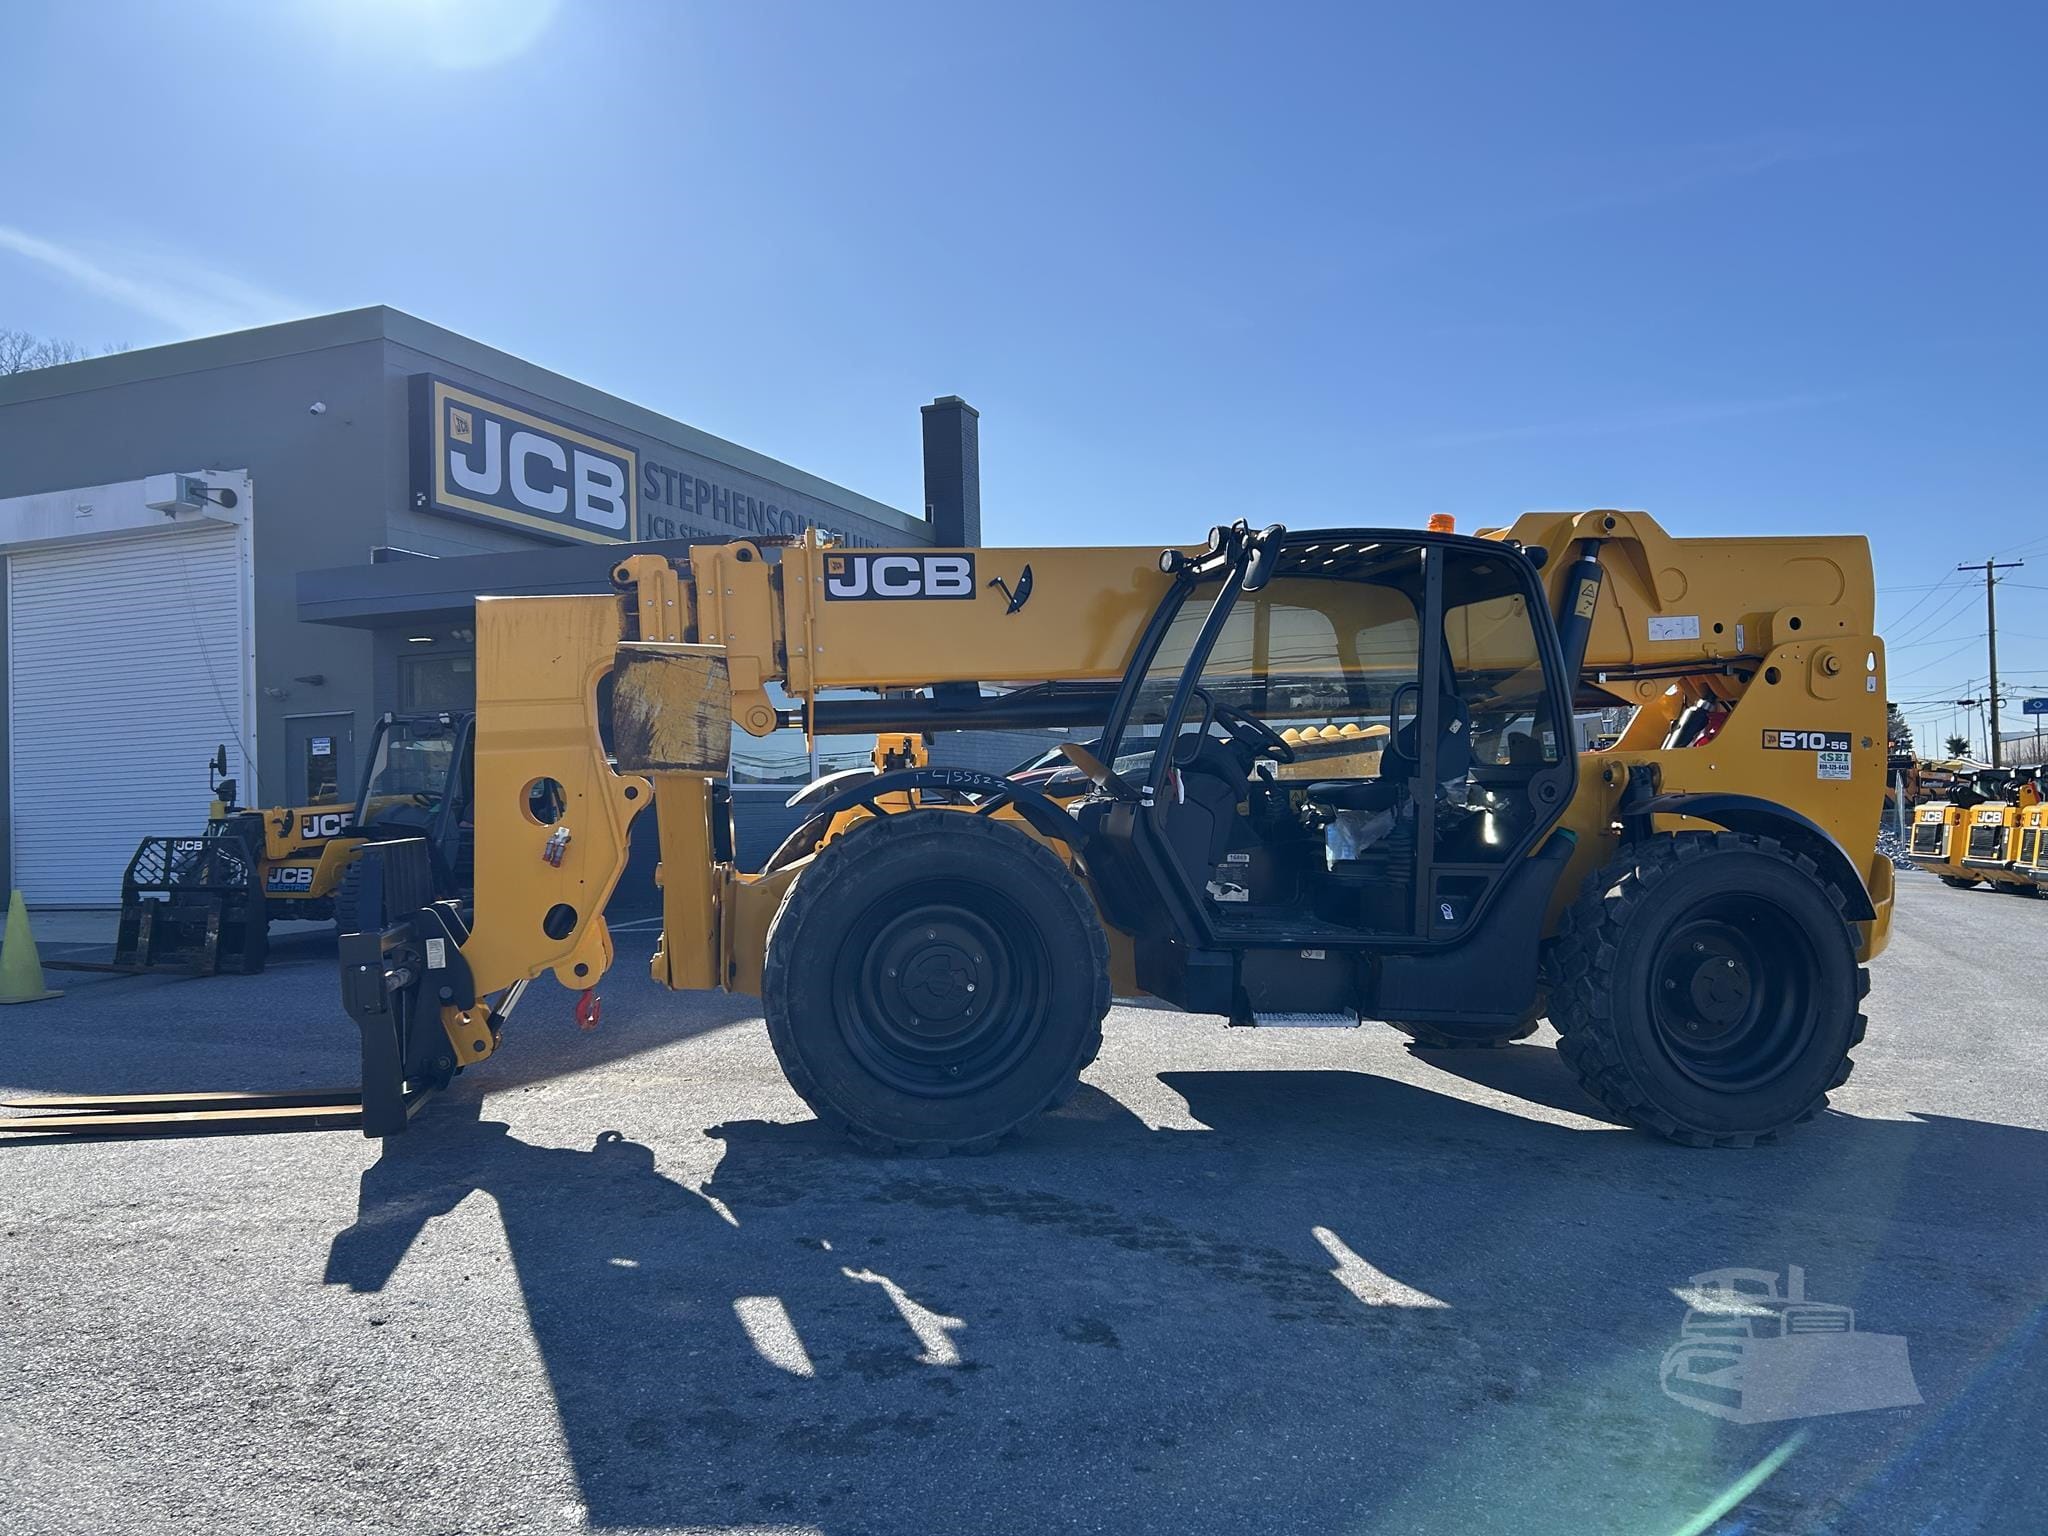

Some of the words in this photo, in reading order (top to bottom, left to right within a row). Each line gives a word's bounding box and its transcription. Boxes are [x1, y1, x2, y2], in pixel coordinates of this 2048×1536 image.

[451, 419, 627, 531] JCB
[829, 556, 973, 597] JCB
[1779, 731, 1848, 750] 510-56
[1827, 753, 1849, 762] SEI
[1921, 811, 1942, 822] JCB
[1978, 811, 2002, 823] JCB
[176, 840, 203, 851] JCB
[268, 868, 313, 883] JCB
[267, 883, 311, 891] ELECTRIC
